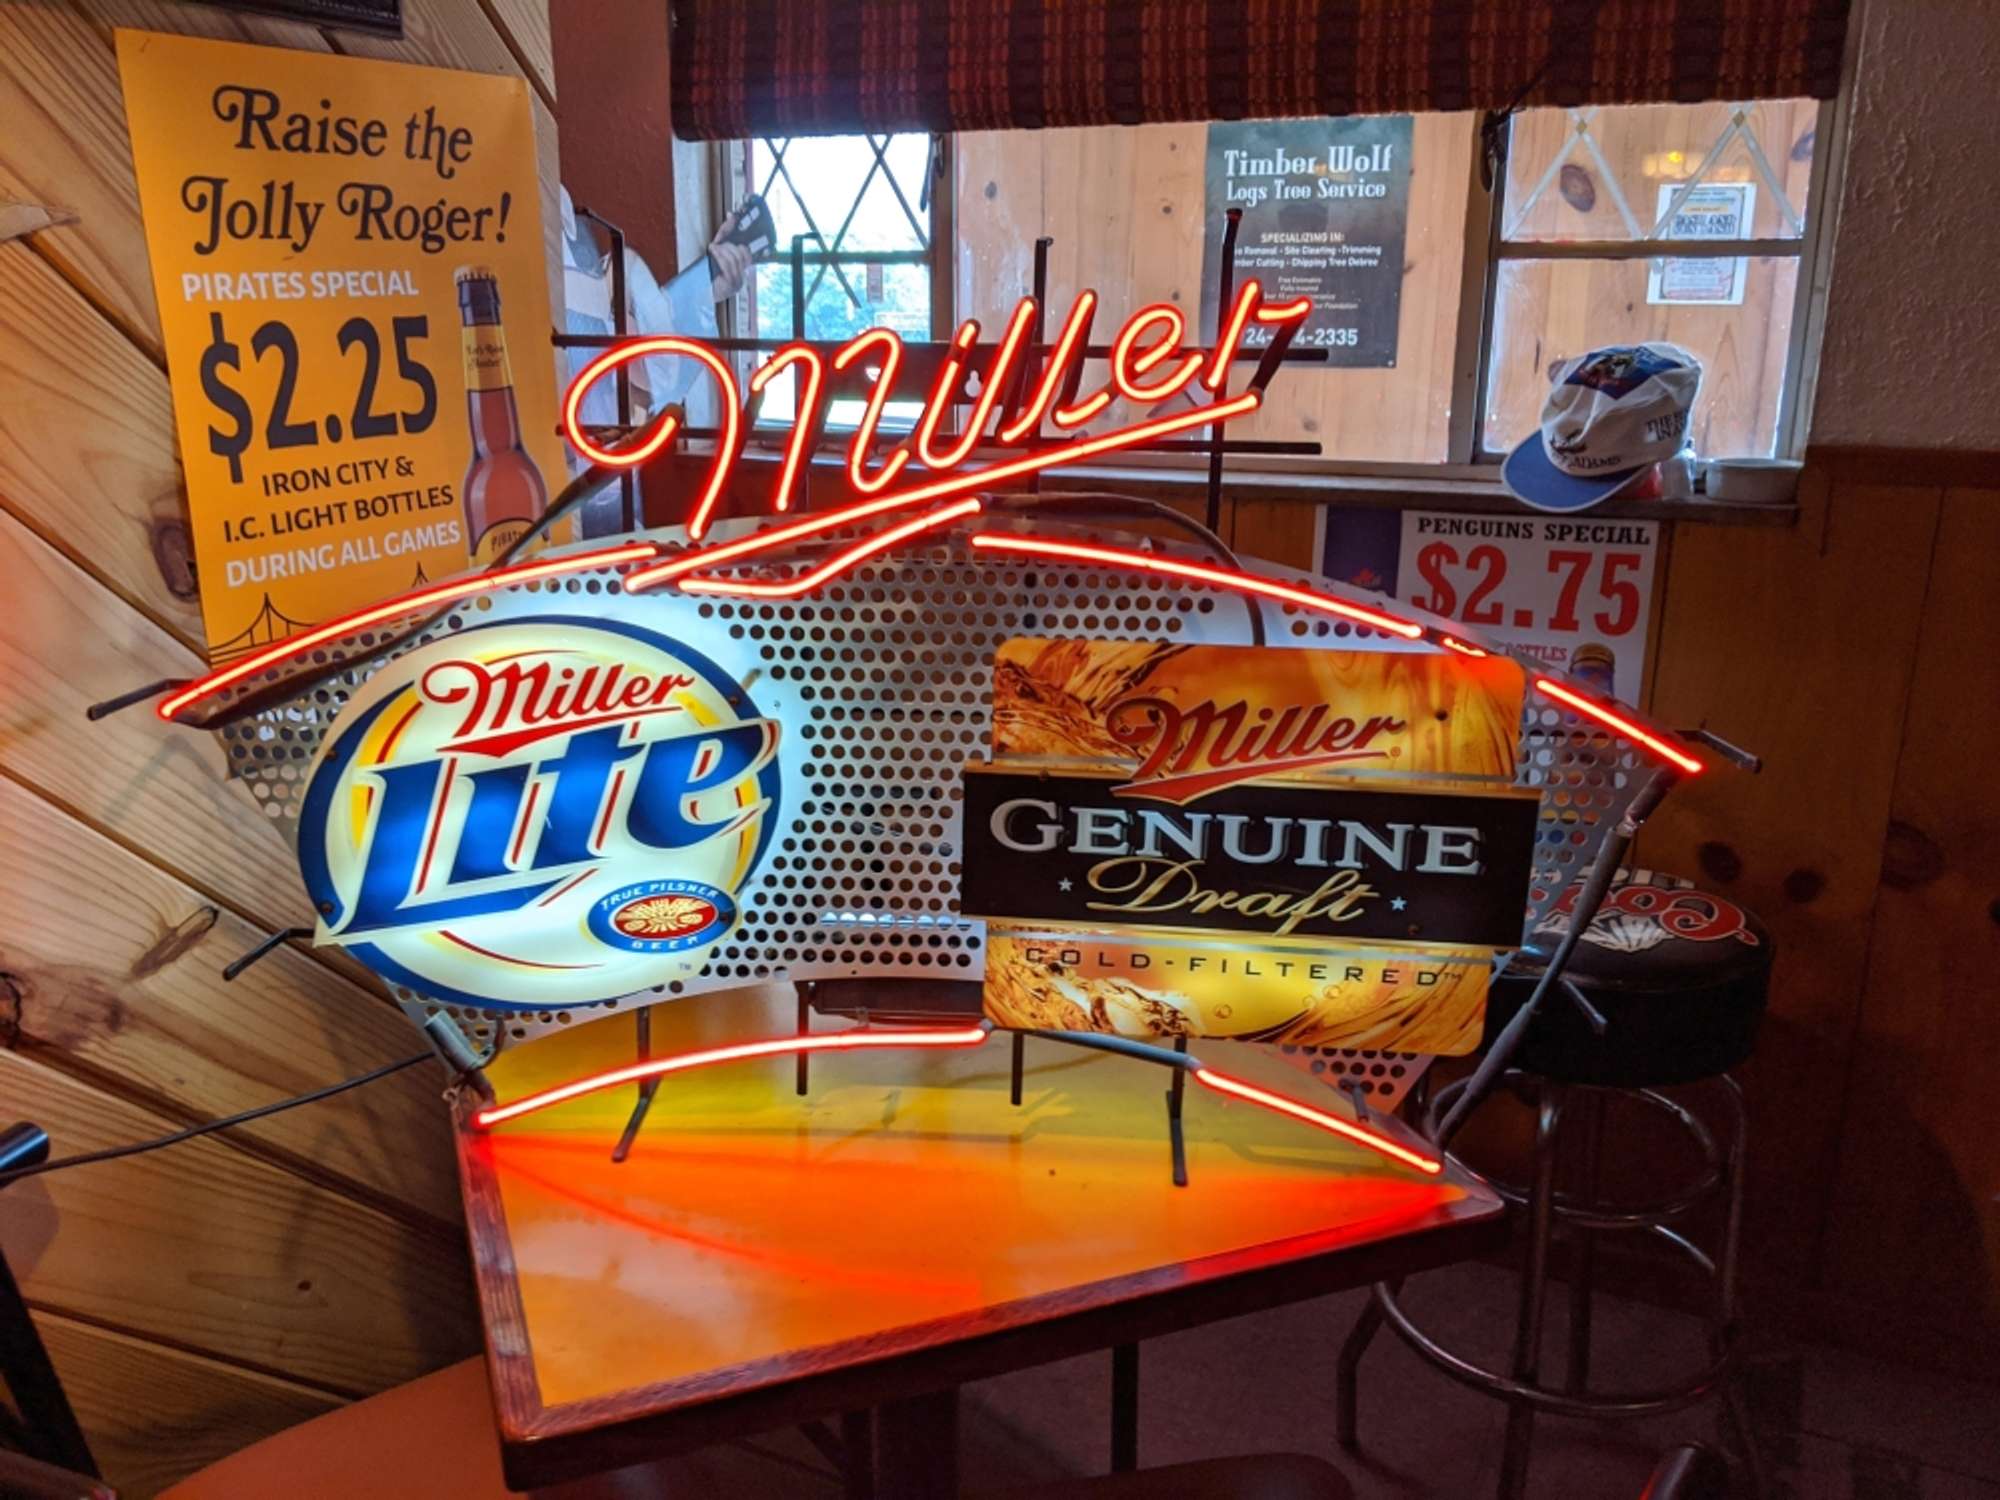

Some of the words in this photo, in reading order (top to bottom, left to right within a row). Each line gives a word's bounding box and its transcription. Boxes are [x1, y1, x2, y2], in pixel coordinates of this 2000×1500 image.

[212, 84, 388, 157] Raise
[404, 106, 473, 180] the
[1224, 147, 1318, 177] Timber
[1328, 144, 1393, 173] Wolf
[181, 175, 325, 256] Jolly
[337, 182, 512, 254] Roger!
[1226, 180, 1267, 207] Logs
[1274, 179, 1311, 199] Tree
[1318, 177, 1386, 198] Service
[1261, 232, 1328, 244] SPECIALIZING
[182, 270, 306, 301] PIRATES
[311, 270, 419, 299] SPECIAL
[200, 312, 438, 484] $2.25
[560, 279, 1312, 541] Miller
[262, 467, 331, 497] IRON
[336, 457, 390, 486] CITY
[395, 456, 415, 477] &
[224, 518, 265, 543] I.C.
[271, 500, 348, 537] LIGHT
[355, 485, 454, 518] BOTTLES
[1418, 516, 1534, 540] PENGUINS
[1544, 522, 1651, 545] SPECIAL
[226, 545, 336, 588] DURING
[341, 539, 379, 567] ALL
[384, 521, 461, 557] GAMES
[1412, 540, 1641, 637] $2.75
[421, 660, 695, 738] Miller
[1105, 699, 1406, 782] Miller
[330, 720, 779, 937] Lite
[989, 799, 1486, 877] GENUINE
[600, 885, 644, 911] TRUE
[650, 881, 720, 899] PILSNER
[1086, 856, 1380, 936] Draft
[631, 936, 699, 950] BEER
